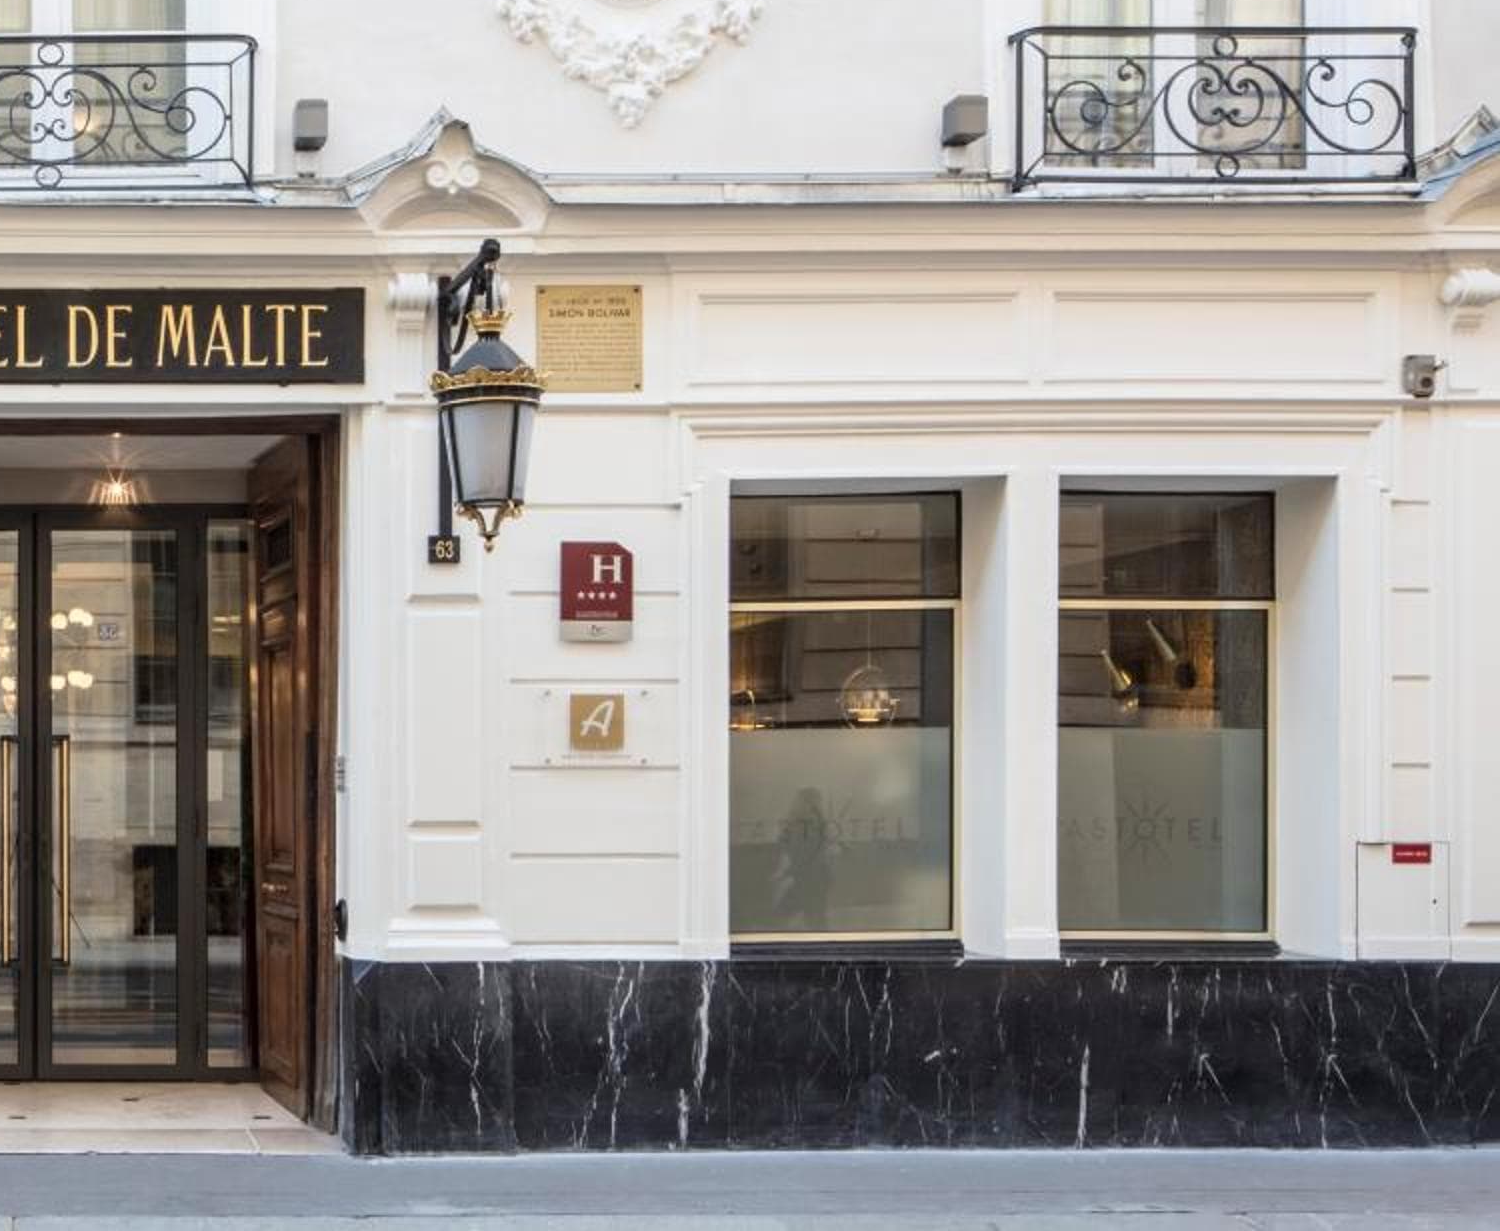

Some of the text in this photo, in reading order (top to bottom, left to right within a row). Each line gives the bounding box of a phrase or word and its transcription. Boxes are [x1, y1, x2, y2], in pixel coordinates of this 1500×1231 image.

[67, 304, 133, 367] DE
[156, 304, 329, 367] MALTE
[435, 540, 454, 559] 63
[589, 554, 625, 584] H
